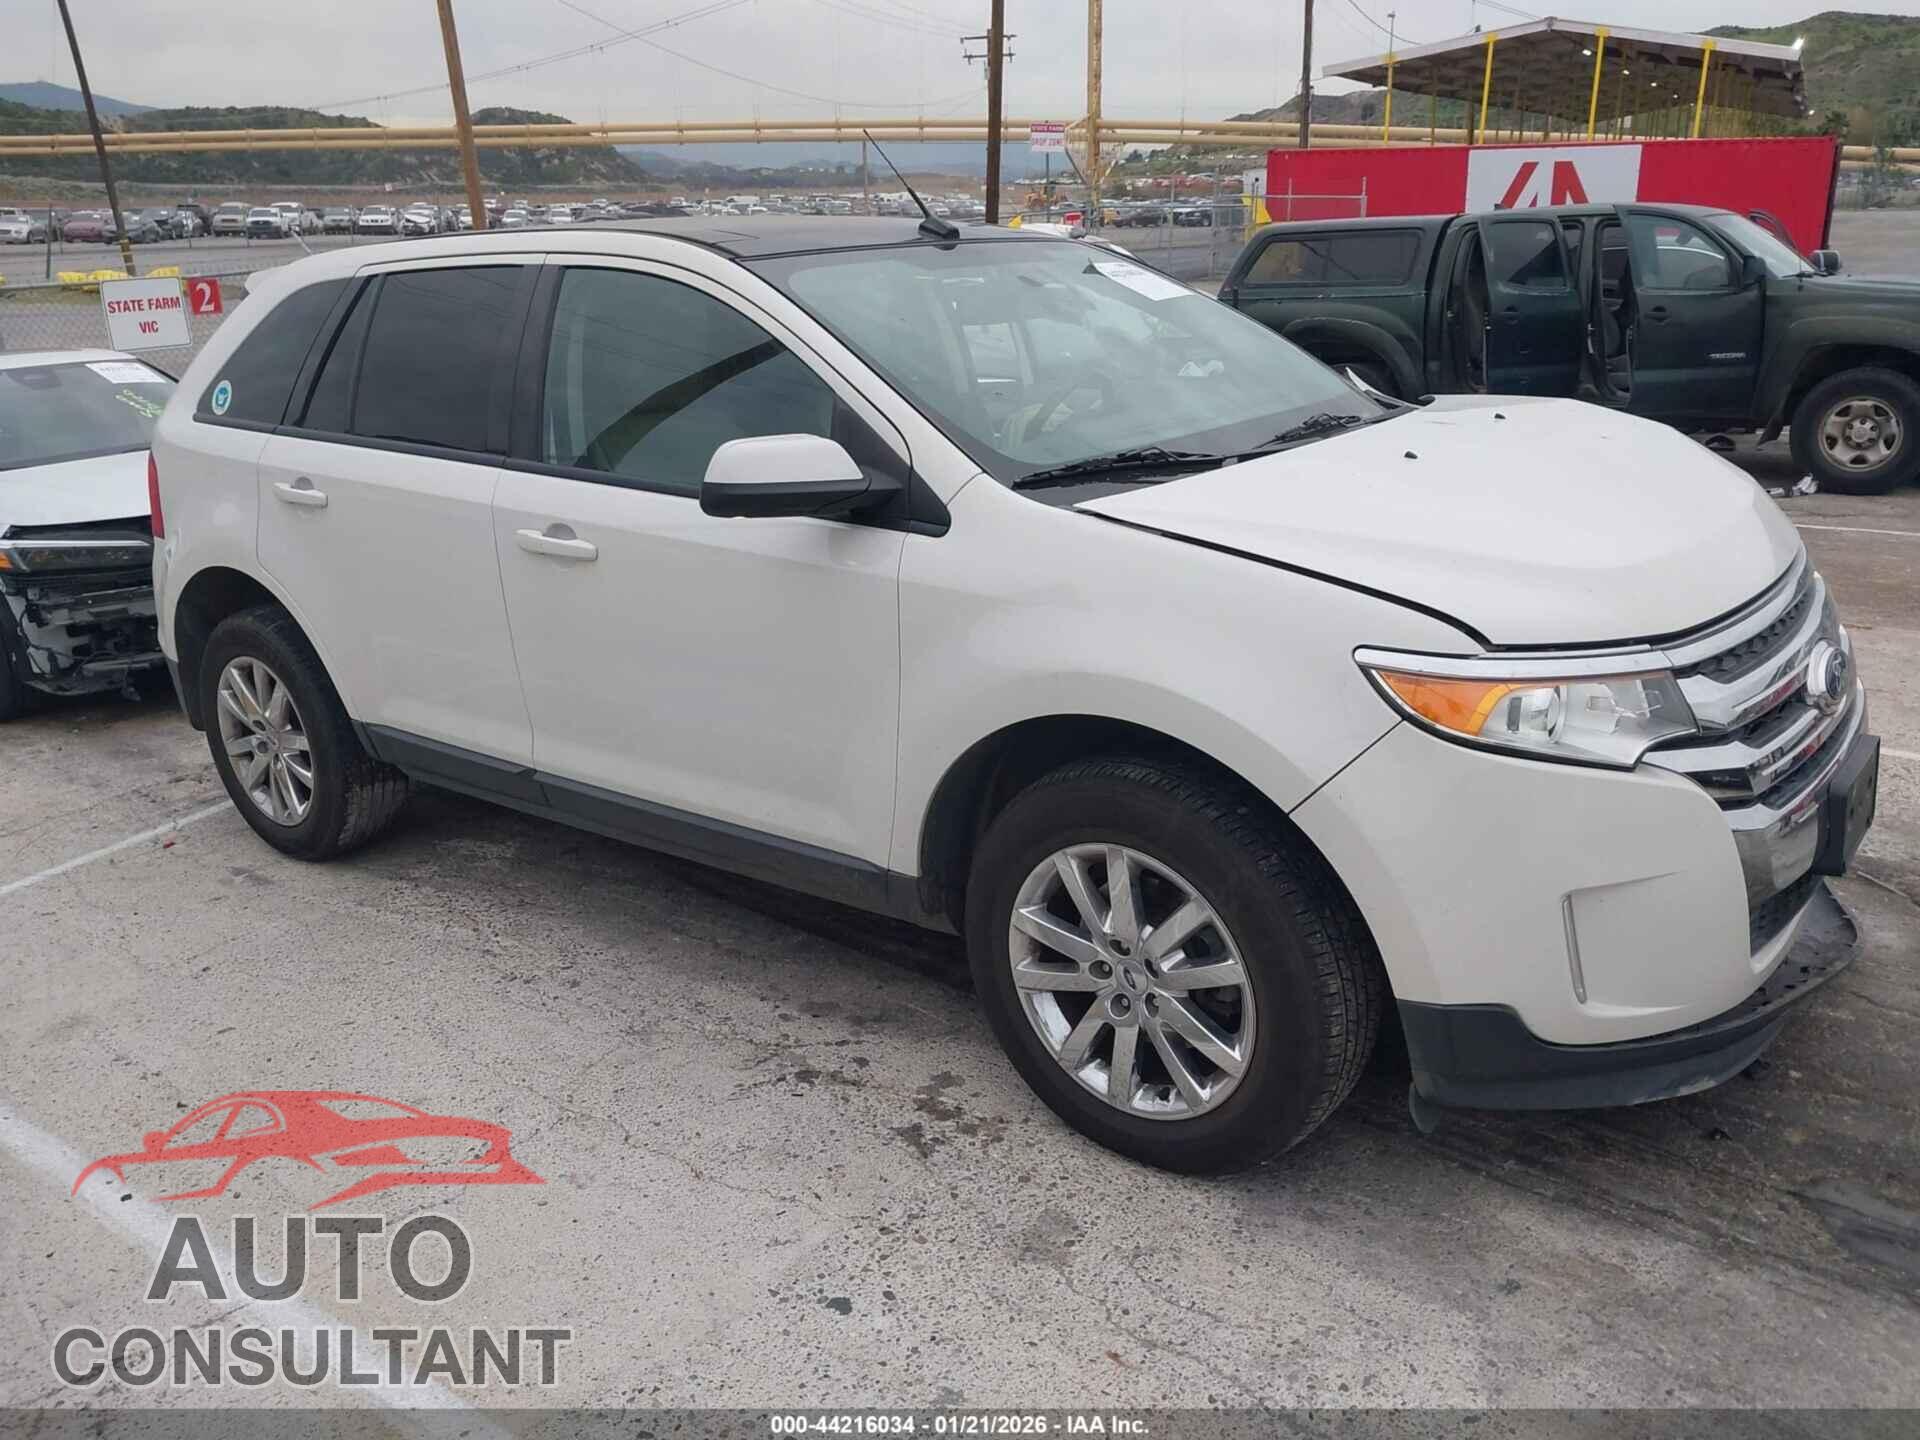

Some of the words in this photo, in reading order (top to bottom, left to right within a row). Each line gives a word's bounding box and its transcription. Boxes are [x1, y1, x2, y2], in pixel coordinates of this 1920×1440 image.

[107, 299, 145, 314] STATE
[148, 296, 181, 311] FARM
[196, 282, 215, 312] 2
[138, 320, 160, 334] VIC
